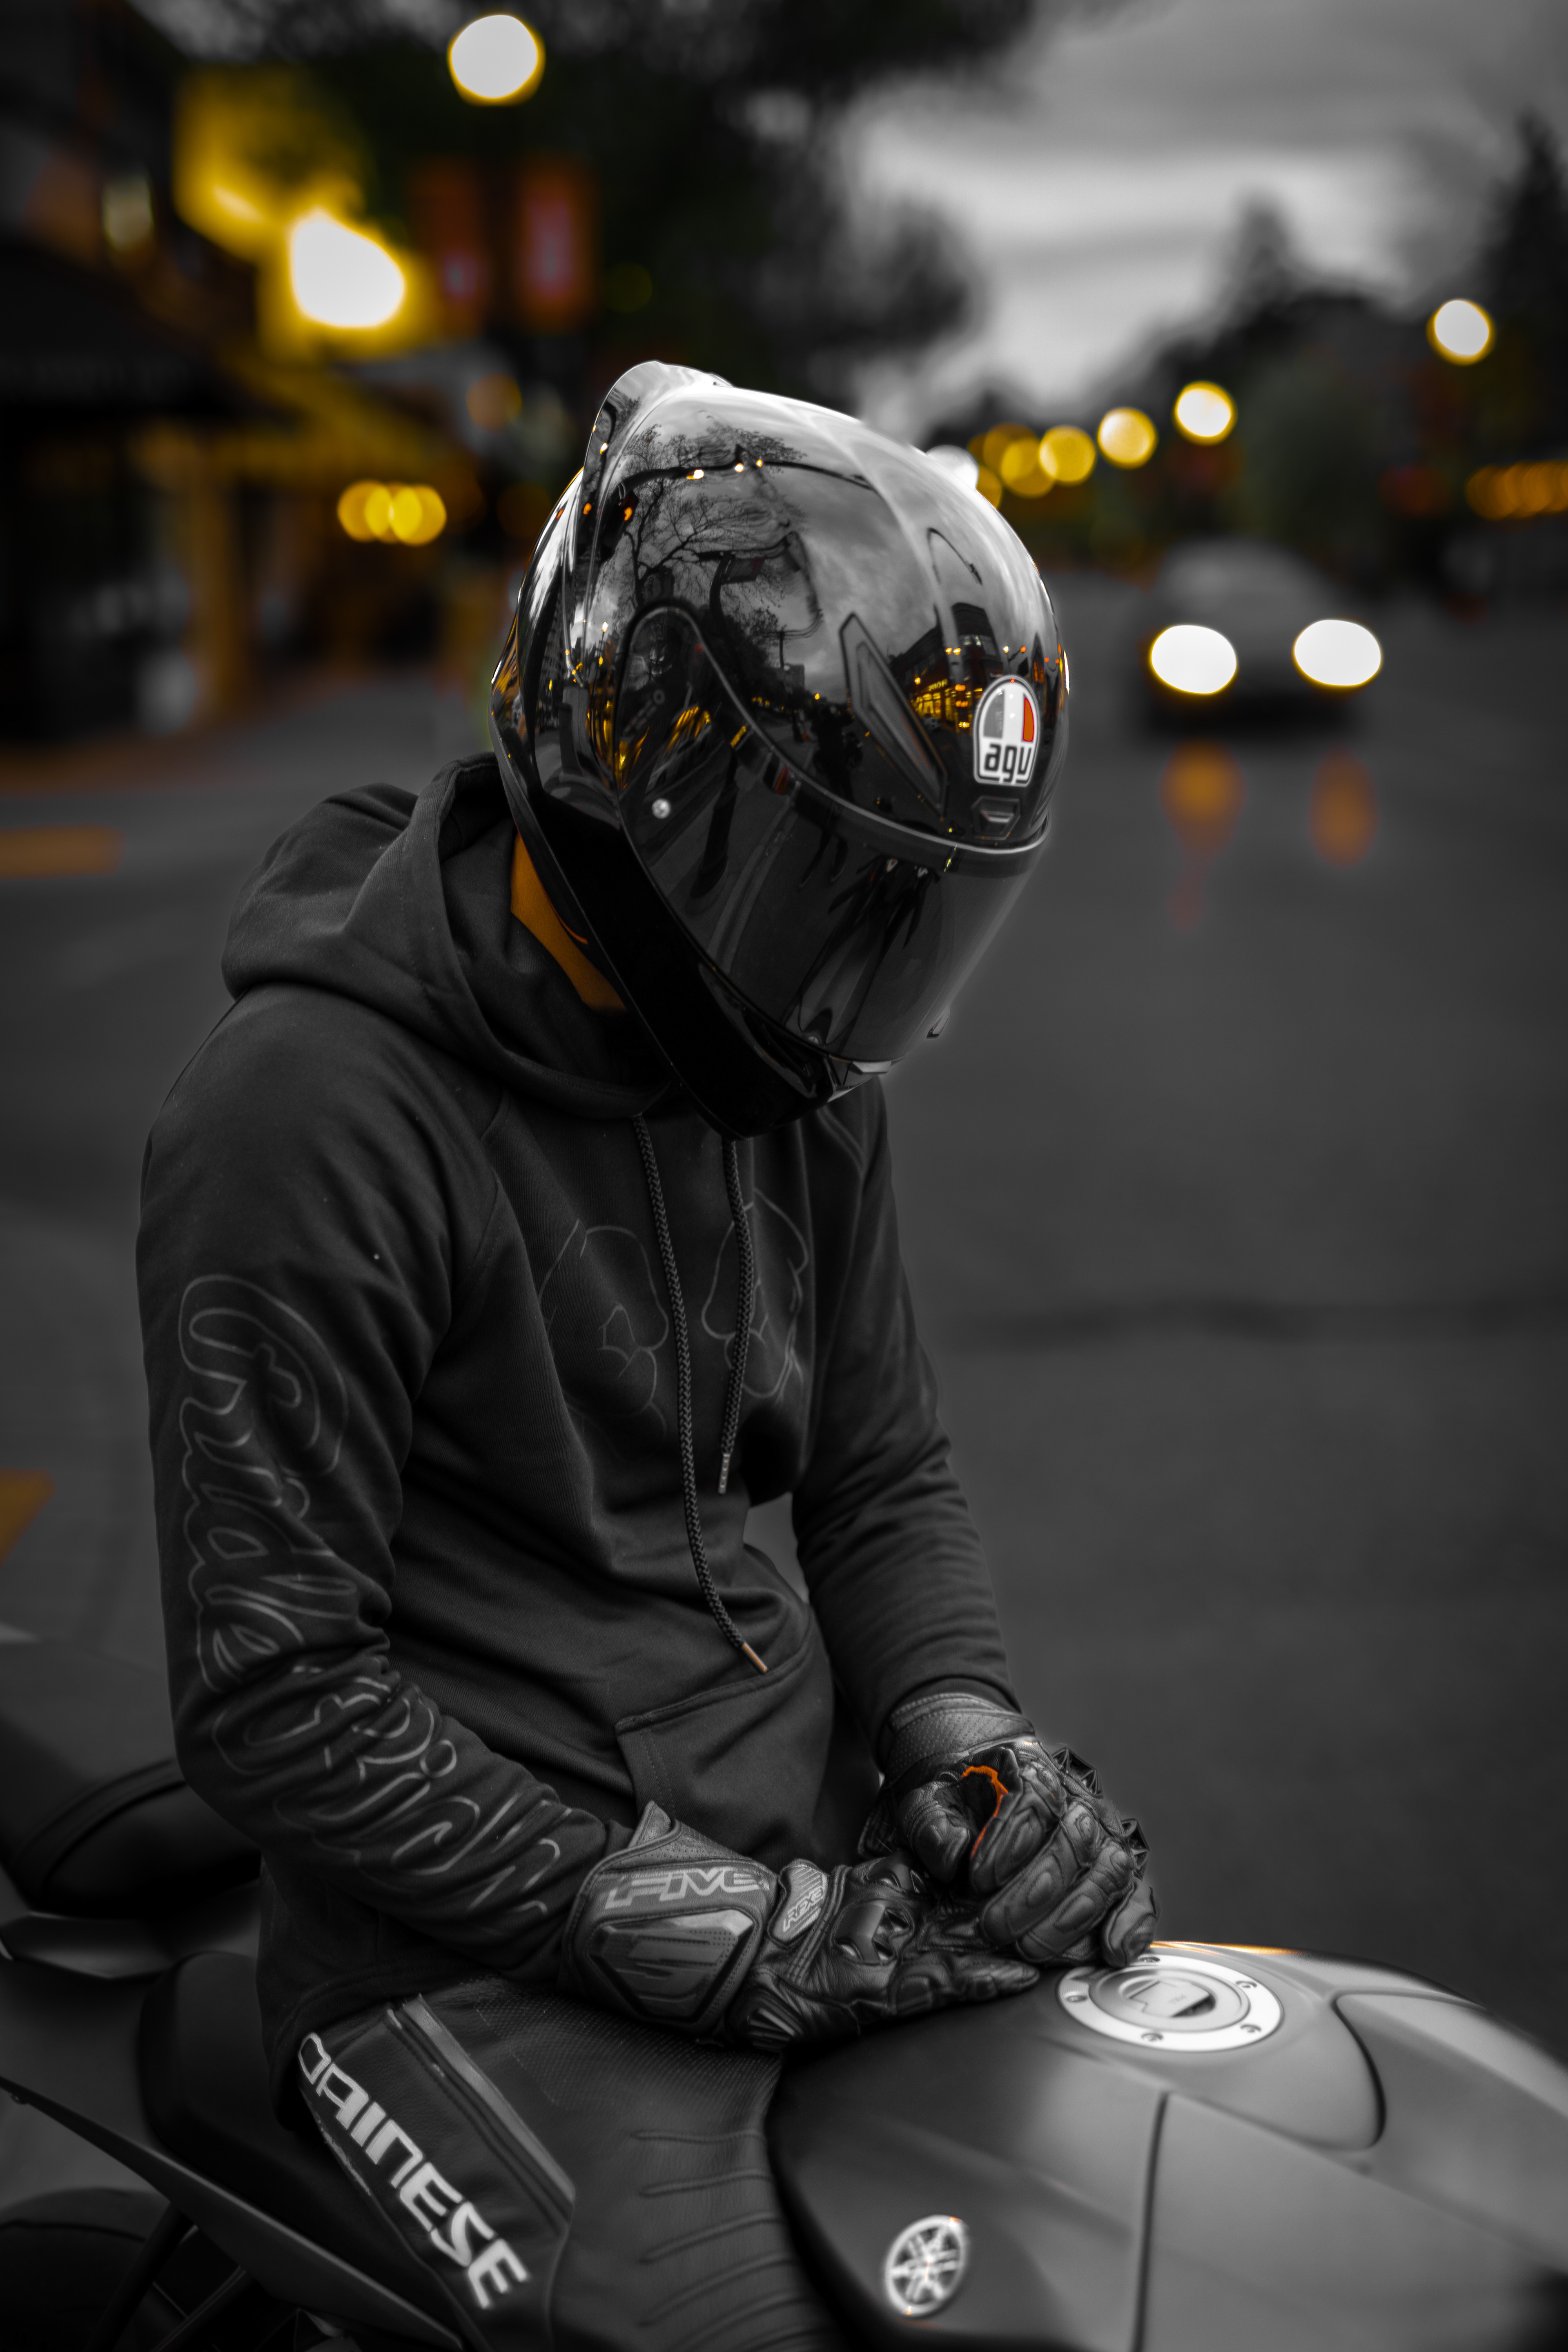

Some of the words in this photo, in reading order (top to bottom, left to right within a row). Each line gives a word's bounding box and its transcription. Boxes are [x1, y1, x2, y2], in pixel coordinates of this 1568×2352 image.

[984, 744, 1031, 783] agv
[604, 1866, 770, 1909] FIVE
[297, 2031, 530, 2310] DAINESE
